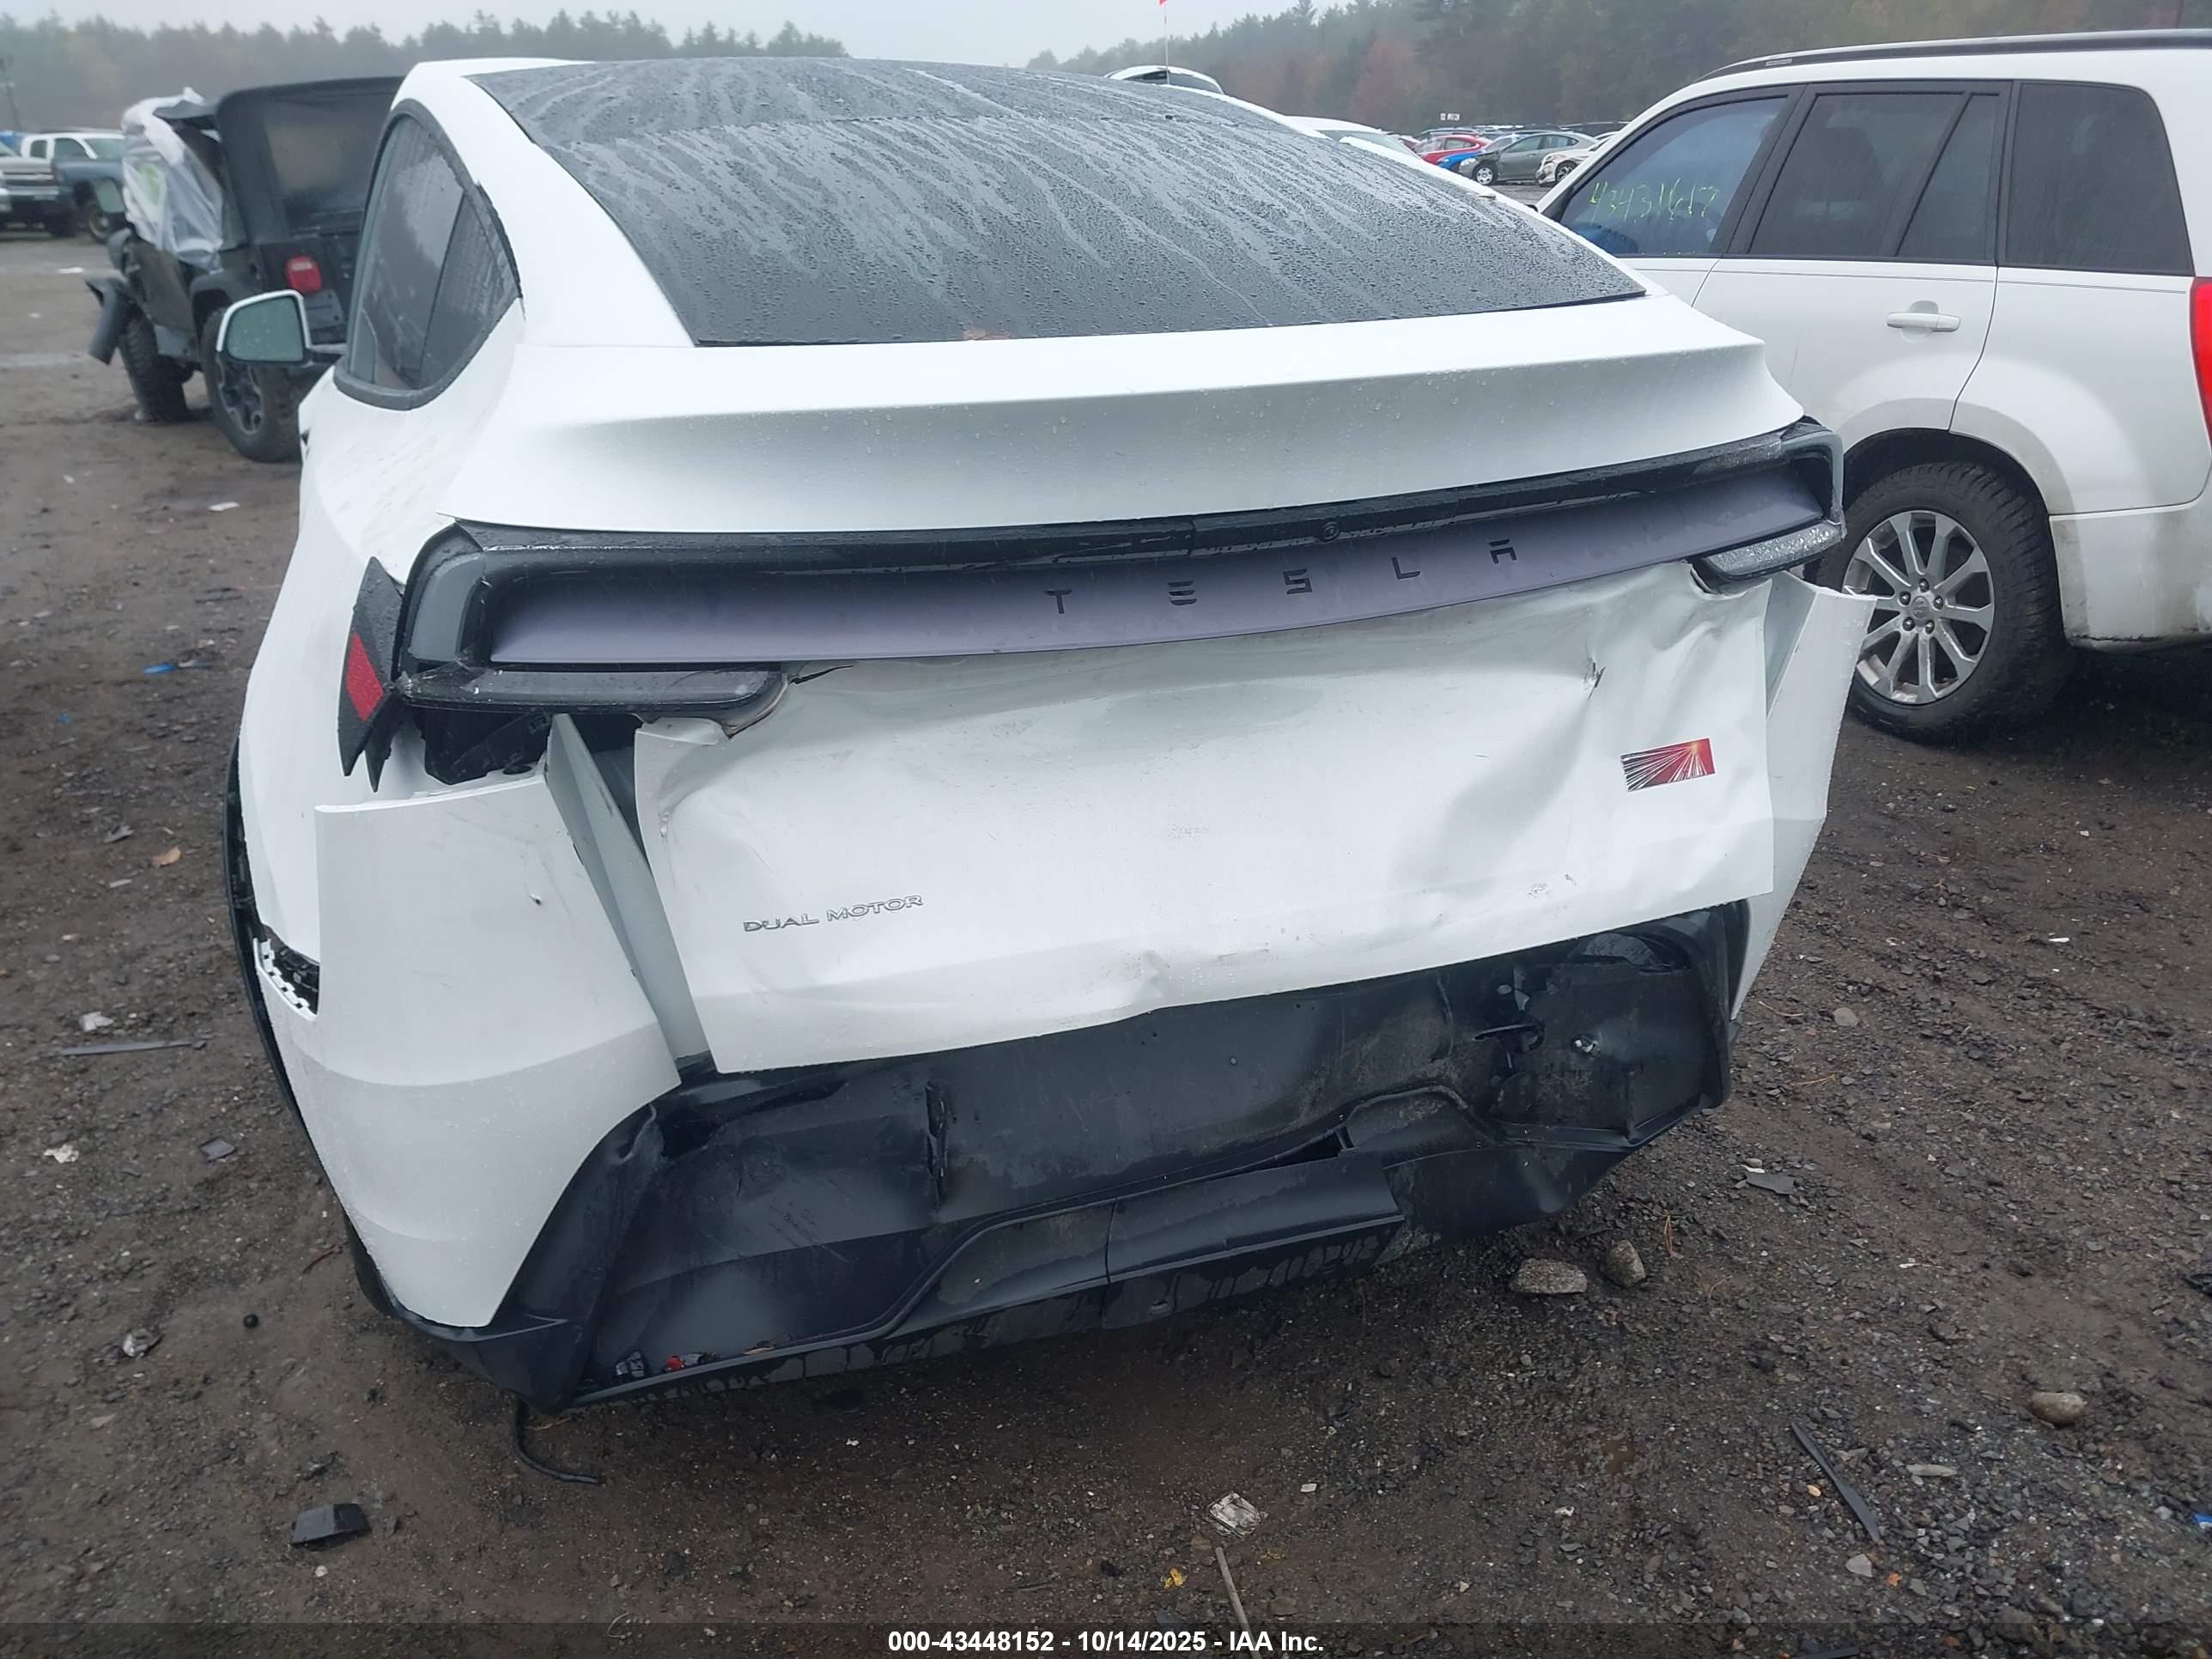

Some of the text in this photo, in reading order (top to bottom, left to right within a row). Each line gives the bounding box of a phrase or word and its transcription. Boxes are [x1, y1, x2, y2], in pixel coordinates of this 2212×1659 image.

[1044, 538, 1518, 615] TESLA
[743, 895, 924, 933] DUAL MOTOR
